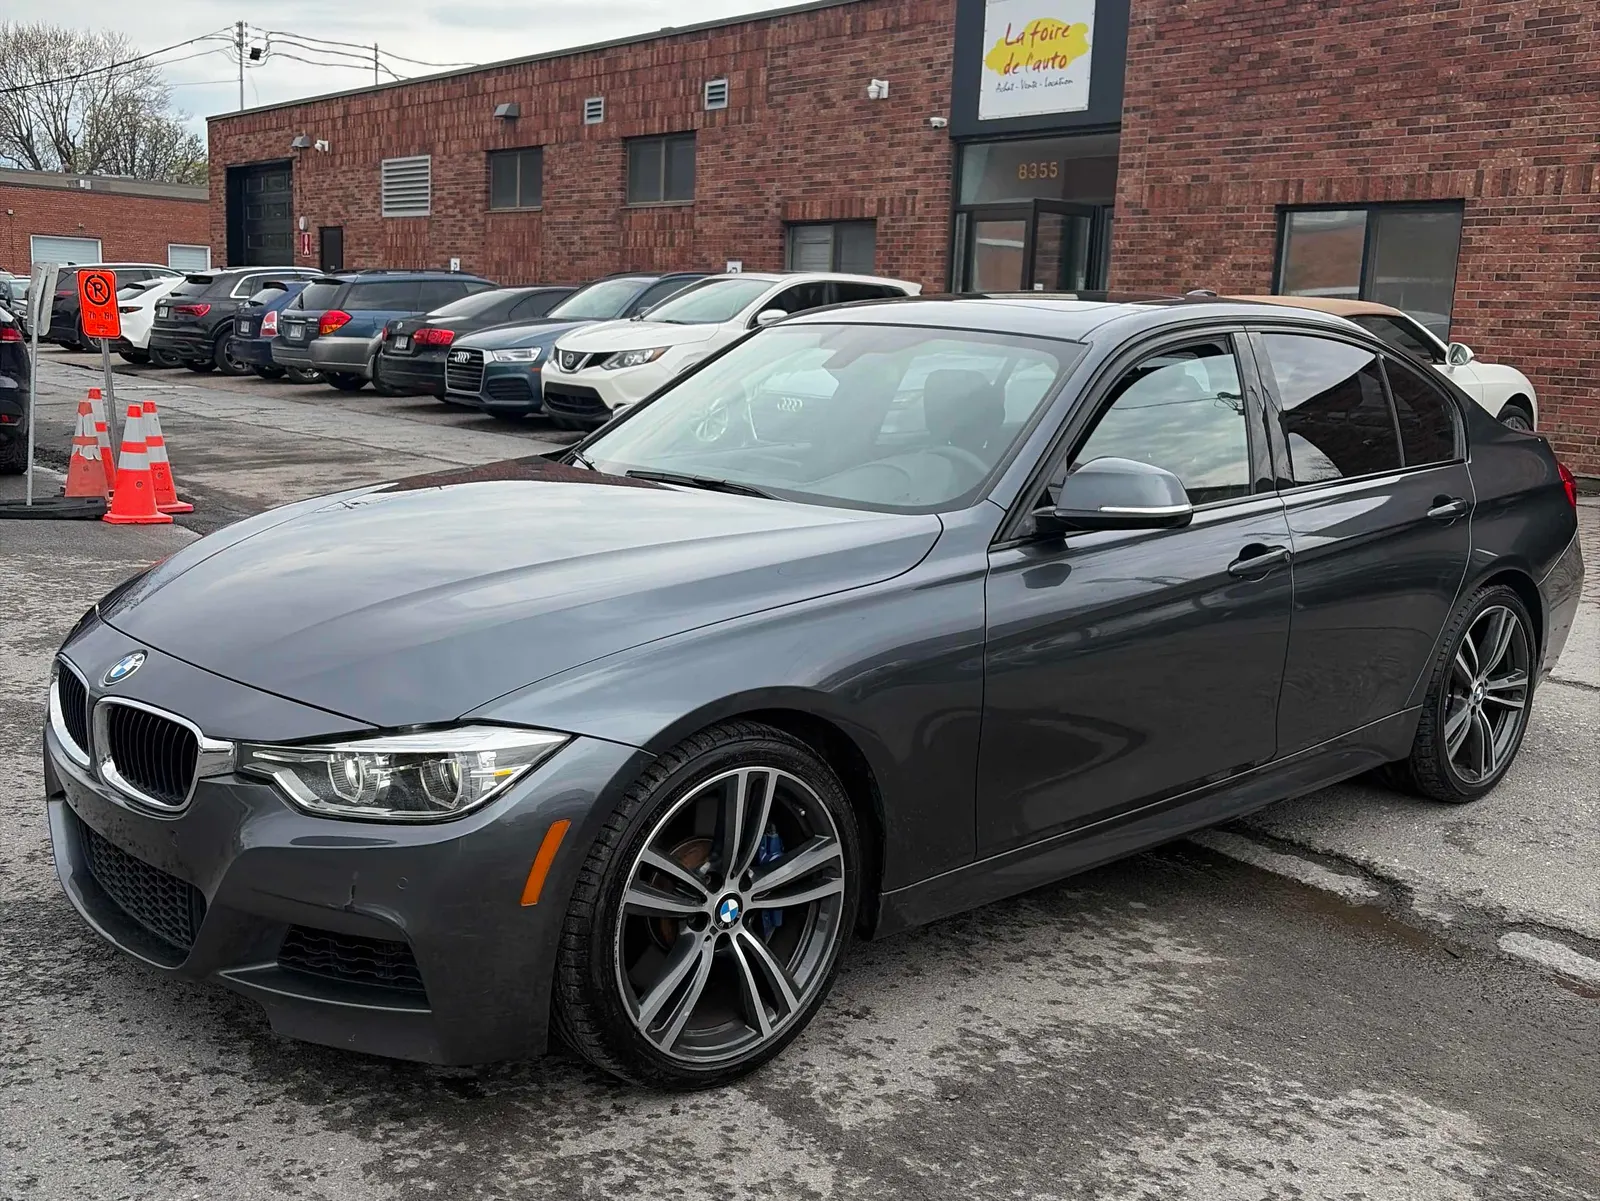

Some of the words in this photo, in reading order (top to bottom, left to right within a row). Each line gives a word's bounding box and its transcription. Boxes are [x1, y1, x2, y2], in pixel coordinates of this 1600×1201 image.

[1005, 22, 1025, 46] La
[1030, 21, 1070, 48] foire
[1003, 52, 1020, 76] de
[1025, 51, 1067, 73] l'auto
[995, 81, 1014, 93] Achat
[1020, 79, 1037, 90] Vente
[1044, 77, 1073, 88] Location
[1018, 161, 1058, 180] 8355
